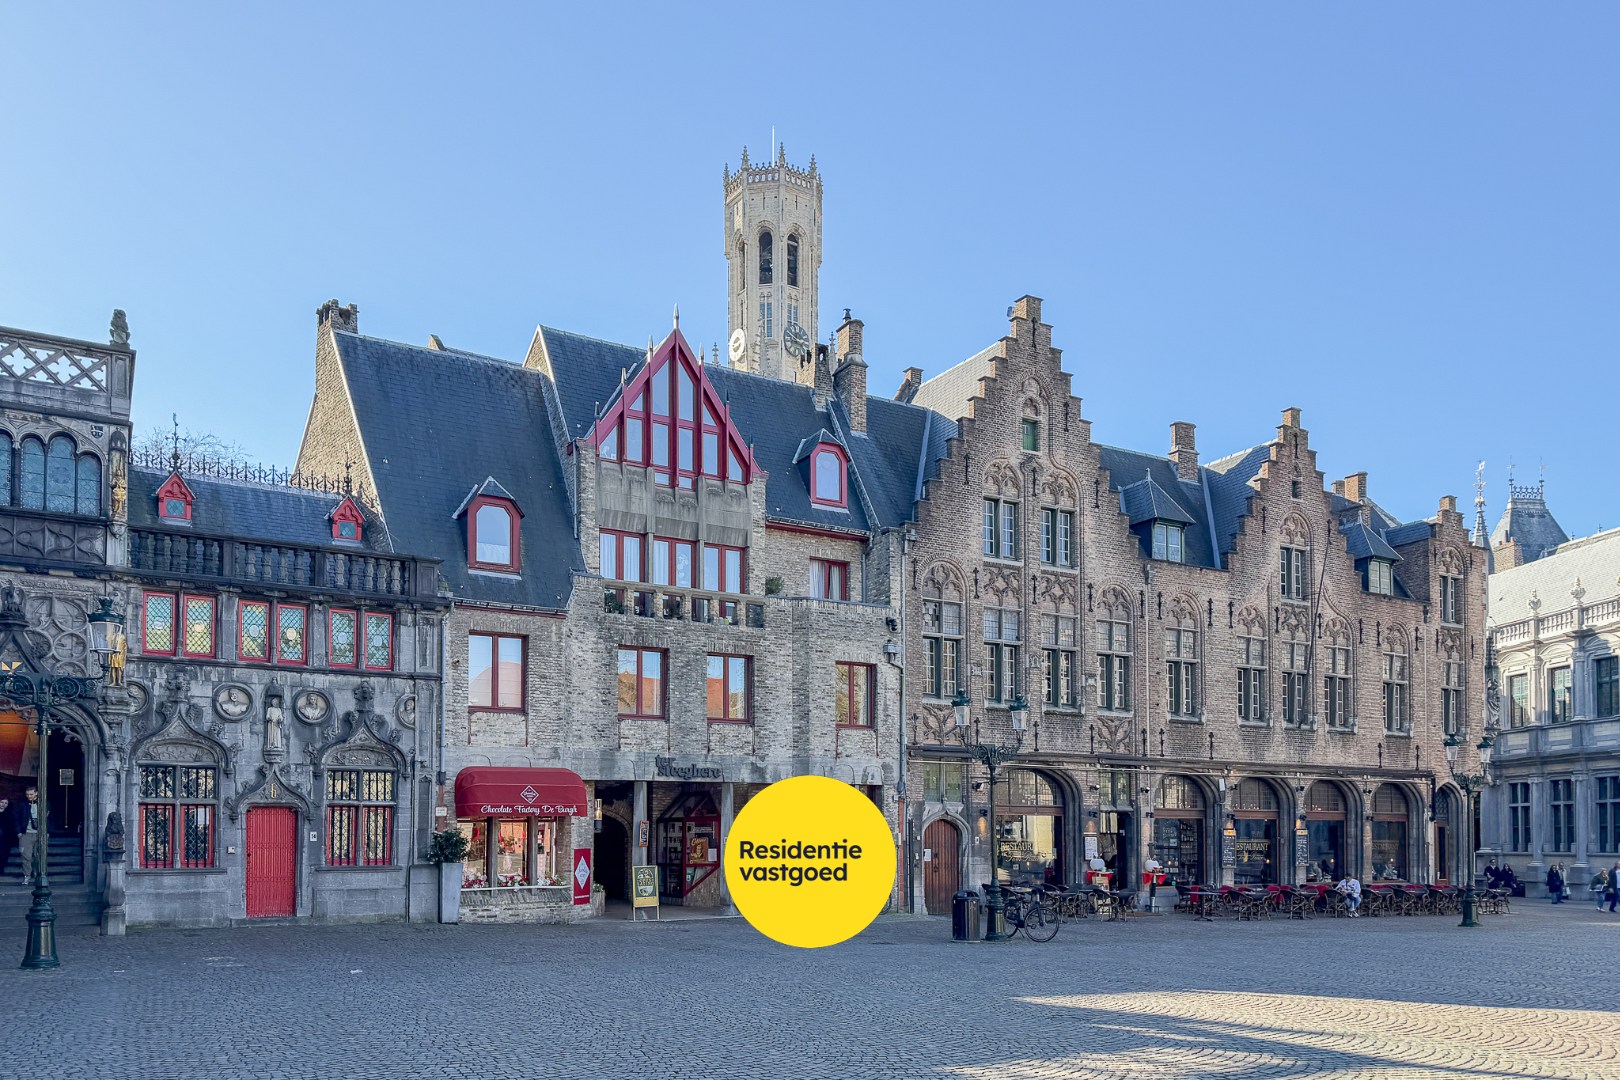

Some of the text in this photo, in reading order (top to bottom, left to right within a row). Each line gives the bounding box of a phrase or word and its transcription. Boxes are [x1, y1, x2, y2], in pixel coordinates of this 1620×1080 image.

[654, 754, 676, 767] ter
[480, 805, 513, 814] Chocolate
[514, 805, 541, 816] Factory
[541, 805, 554, 813] De
[1236, 842, 1268, 851] ESTAURANT
